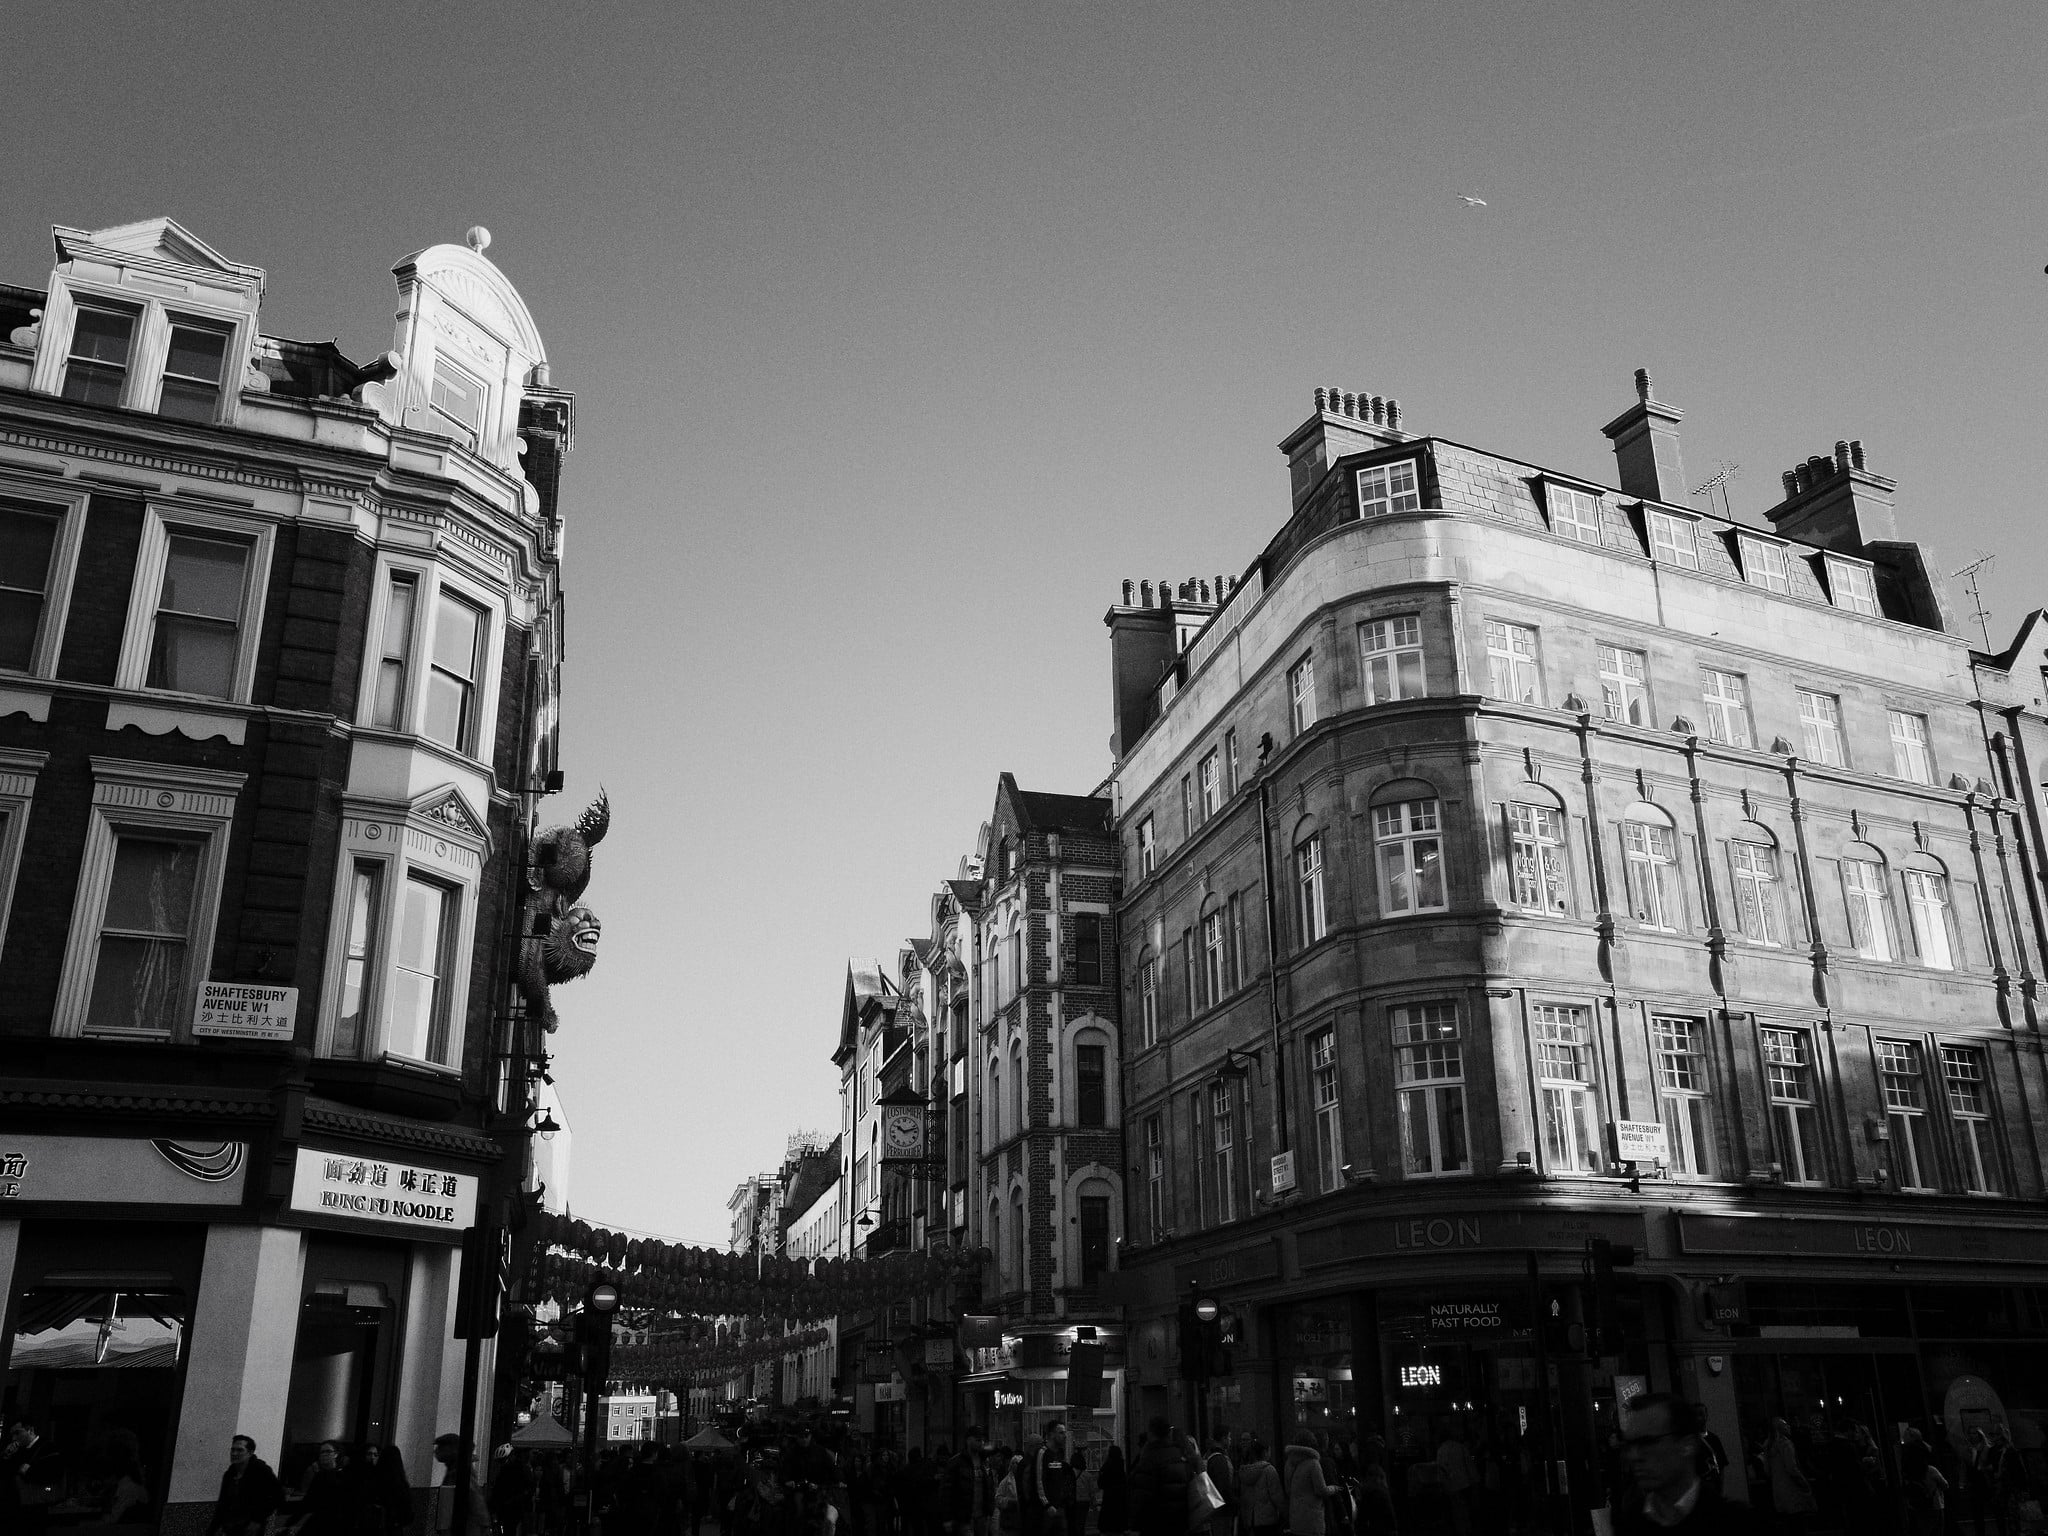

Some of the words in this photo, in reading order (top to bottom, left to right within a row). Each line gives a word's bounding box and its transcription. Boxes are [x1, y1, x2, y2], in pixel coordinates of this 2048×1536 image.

[205, 985, 287, 1002] SHAFTESBURY
[202, 998, 248, 1012] AVENUE
[251, 1001, 269, 1013] W1
[201, 1011, 288, 1028] 沙士比利大道
[221, 1029, 259, 1037] WESTMINSTER
[888, 1106, 922, 1121] COSTUMIER
[1620, 1123, 1661, 1134] SHAFTESBURY
[1621, 1132, 1644, 1142] AVENUE
[1645, 1134, 1654, 1143] W1
[400, 1168, 459, 1198] 味正道
[321, 1190, 367, 1213] KUNG
[368, 1197, 391, 1214] FU
[391, 1200, 456, 1223] NOODLE
[1394, 1216, 1482, 1249] LEON
[1854, 1226, 1912, 1252] LEON
[1209, 1255, 1236, 1282] LEON
[1429, 1303, 1500, 1316] NATURALLY
[1714, 1307, 1739, 1320] LEON
[1431, 1316, 1460, 1329] FAST
[1463, 1315, 1501, 1328] FOOD
[1401, 1364, 1441, 1387] LEON
